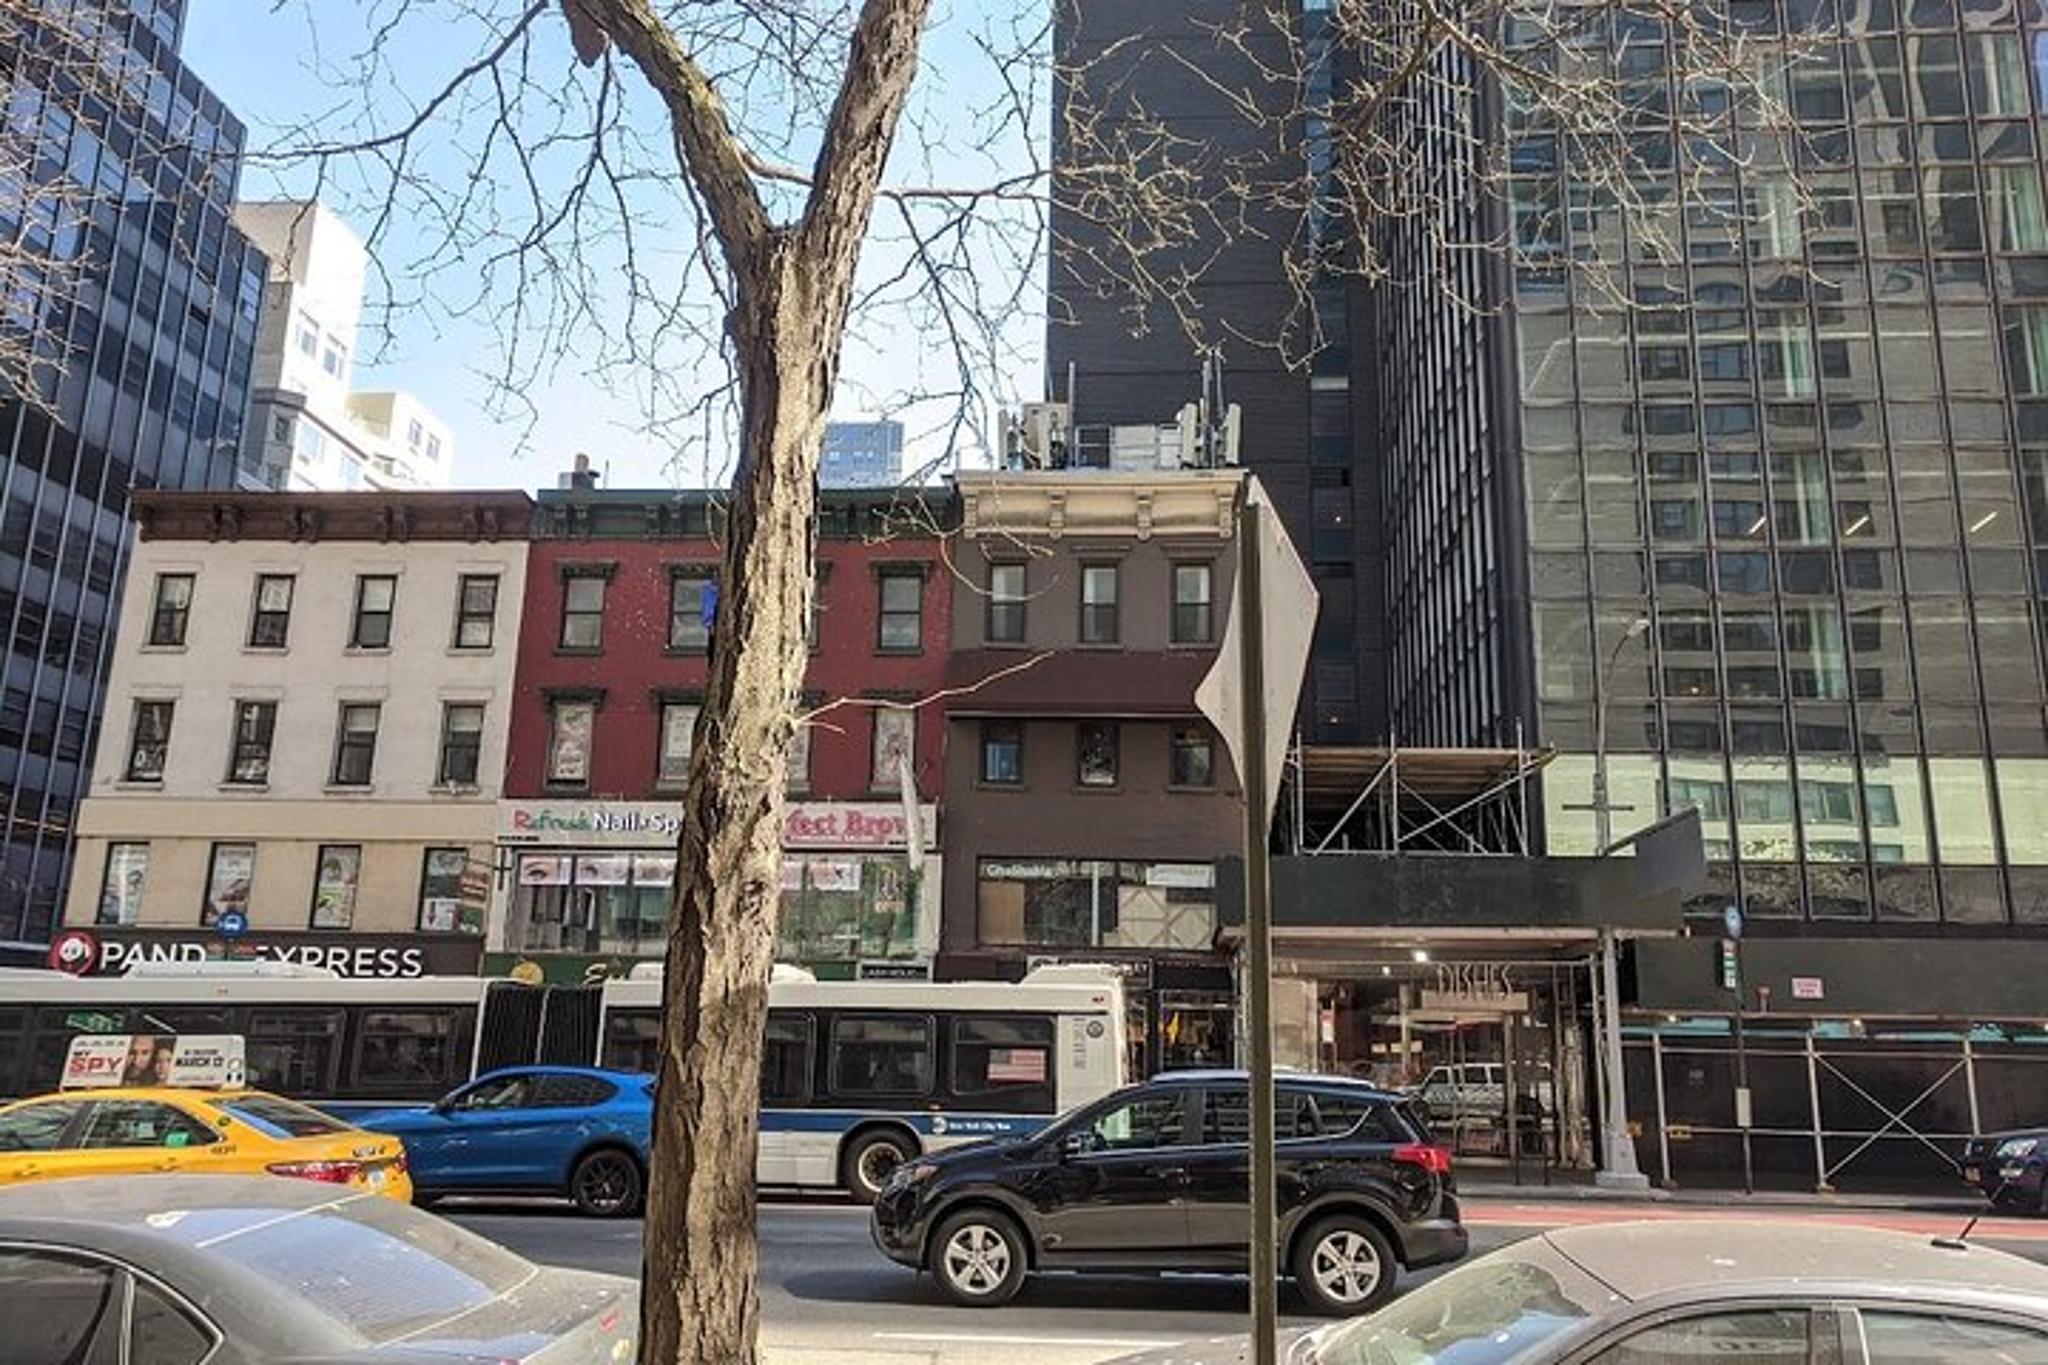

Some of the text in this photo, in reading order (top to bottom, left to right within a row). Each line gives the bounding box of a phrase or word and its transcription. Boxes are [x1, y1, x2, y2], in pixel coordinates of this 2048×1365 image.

[649, 811, 681, 836] Sp
[785, 808, 837, 837] fect
[100, 942, 206, 971] PAND
[69, 1056, 123, 1074] SPY
